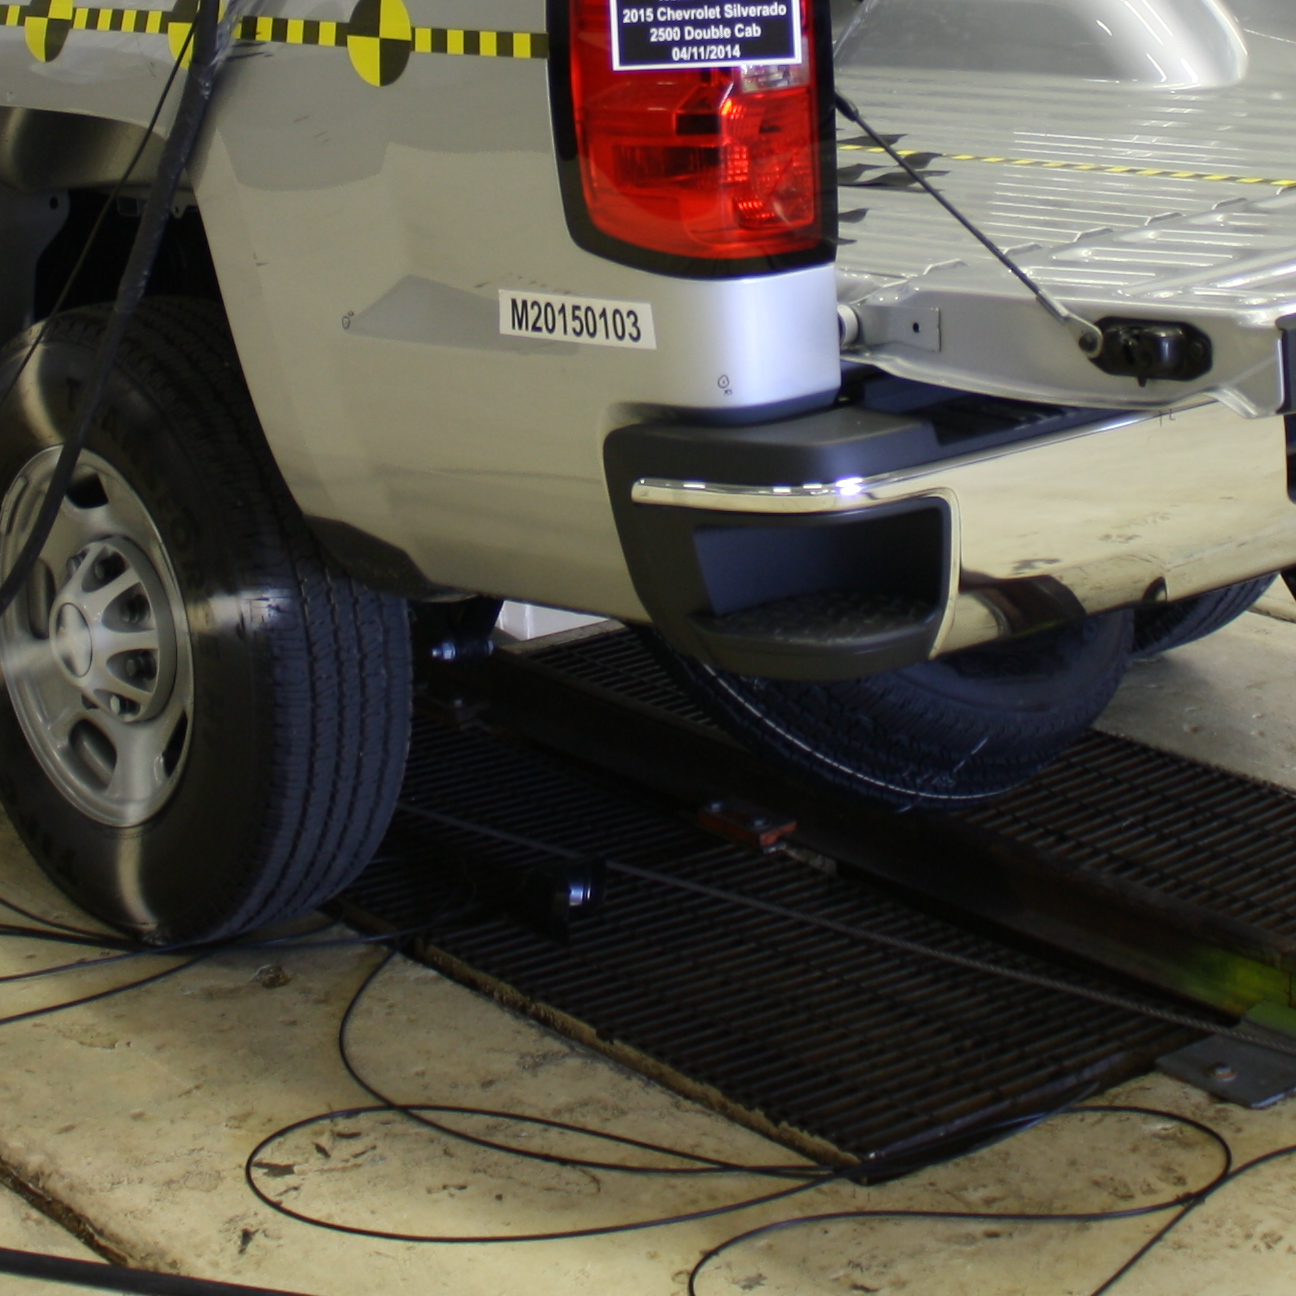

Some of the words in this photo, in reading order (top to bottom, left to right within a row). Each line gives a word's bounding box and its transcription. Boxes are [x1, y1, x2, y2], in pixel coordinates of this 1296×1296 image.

[622, 8, 654, 23] 2015
[656, 4, 721, 21] Chevrolet
[724, 1, 787, 18] Silverado
[650, 27, 681, 42] 2500
[684, 24, 731, 40] Double
[734, 23, 761, 38] Cab
[671, 44, 741, 61] 04/11/2014
[510, 297, 642, 343] M20150103
